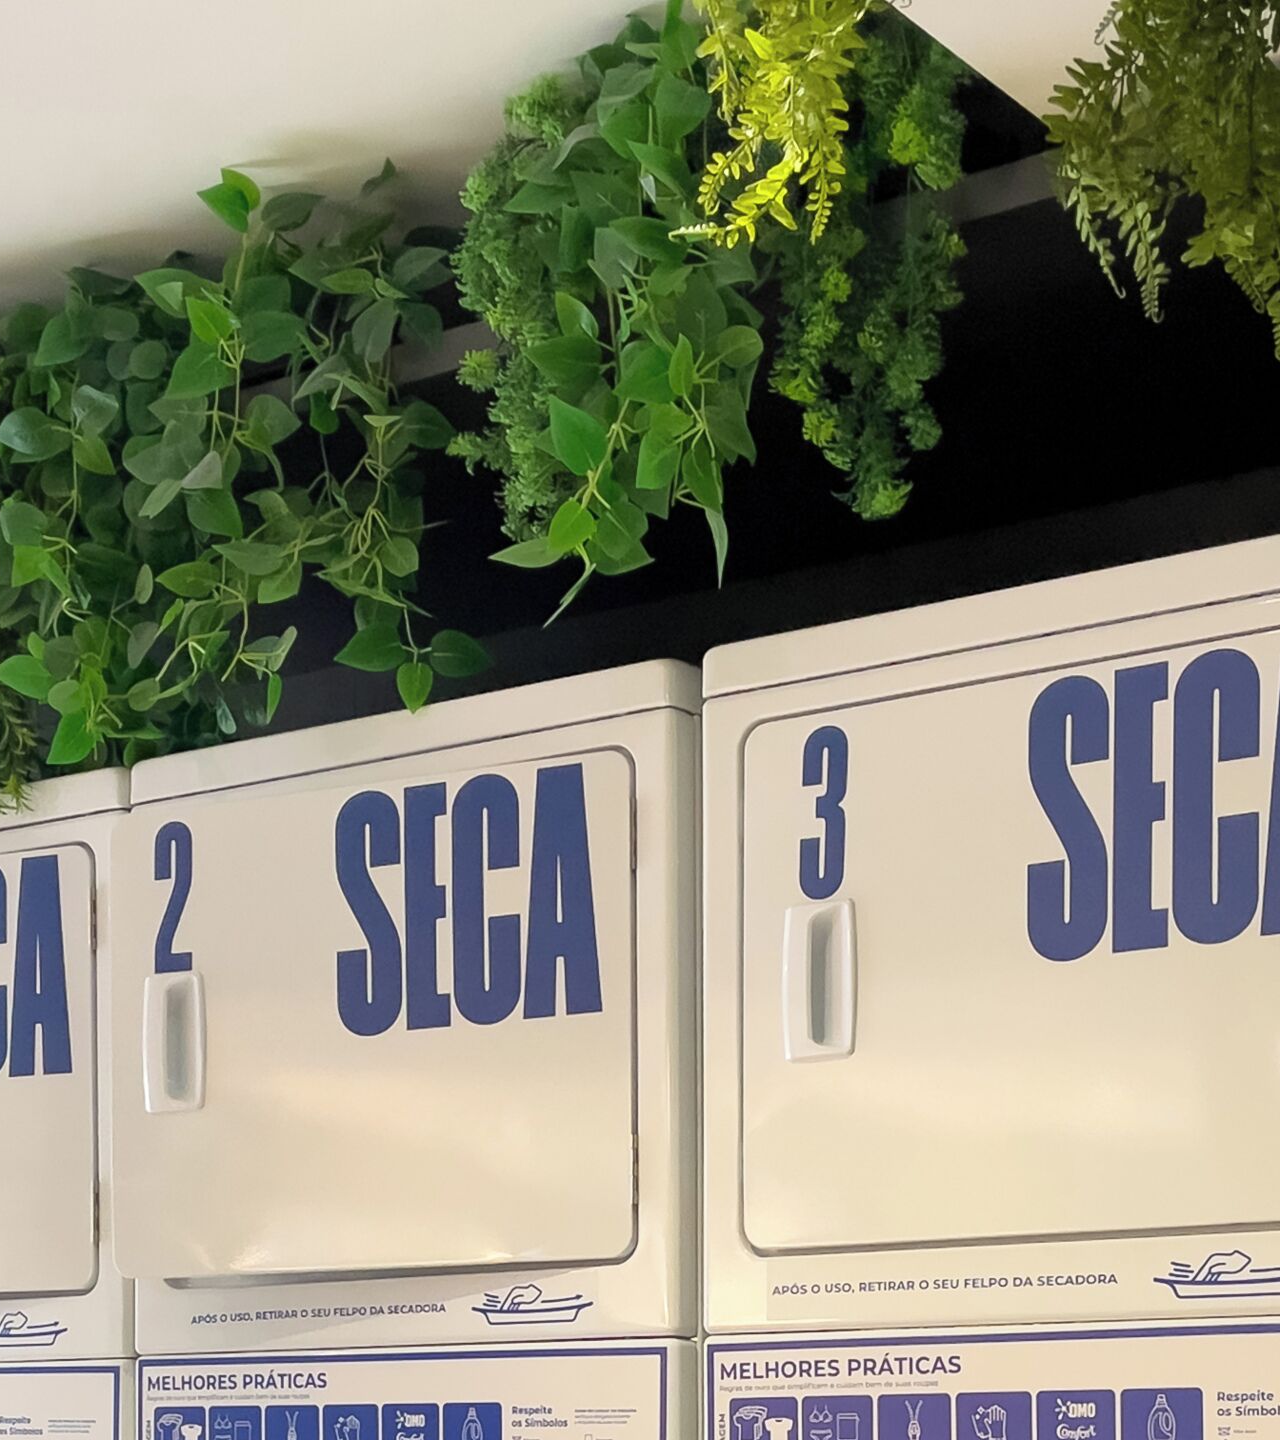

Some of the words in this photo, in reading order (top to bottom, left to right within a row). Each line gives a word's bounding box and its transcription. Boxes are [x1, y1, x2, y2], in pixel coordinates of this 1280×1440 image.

[799, 725, 849, 900] 3
[154, 821, 192, 974] 2
[335, 762, 603, 1037] SECA
[772, 1284, 807, 1295] APÓS
[811, 1284, 820, 1294] O
[824, 1283, 855, 1294] USO,
[859, 1280, 915, 1292] RETIRAR
[919, 1279, 929, 1289] O
[933, 1279, 959, 1289] SEU
[964, 1277, 1009, 1288] FELPO
[1013, 1277, 1033, 1287] DA
[1037, 1274, 1118, 1286] SECADORA
[191, 1315, 217, 1324] APÓS
[255, 1310, 298, 1321] RETIRAR
[301, 1309, 308, 1318] O
[311, 1308, 330, 1317] SEU
[334, 1306, 367, 1317] FELPO
[369, 1306, 385, 1315] DA
[387, 1304, 446, 1314] SECADORA
[720, 1360, 840, 1380] MELHORES
[848, 1353, 961, 1376] PRÁTICAS
[148, 1375, 237, 1391] MELHORES
[243, 1370, 327, 1389] PRÁTICAS
[1217, 1391, 1274, 1403] Respeite
[512, 1406, 552, 1416] Respeite
[1069, 1402, 1096, 1418] OMO
[1217, 1408, 1231, 1416] os
[512, 1420, 522, 1428] os
[525, 1418, 568, 1428] Símbolos
